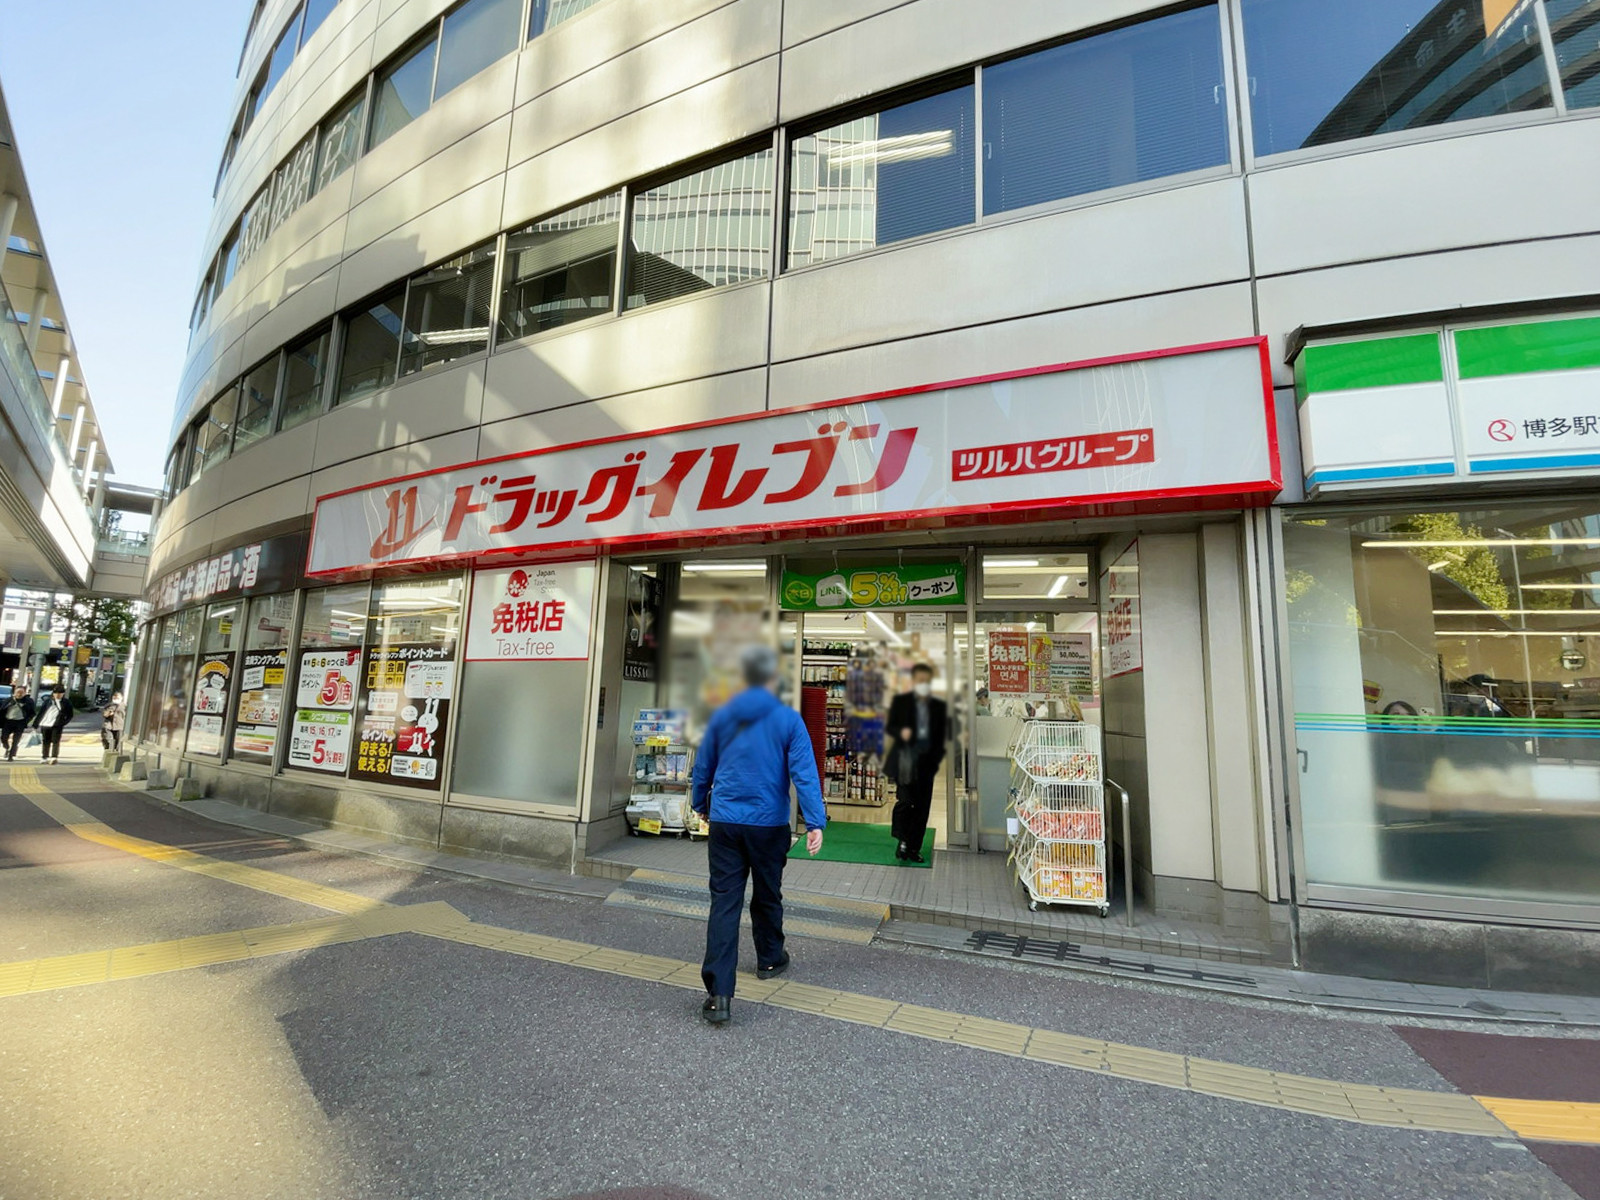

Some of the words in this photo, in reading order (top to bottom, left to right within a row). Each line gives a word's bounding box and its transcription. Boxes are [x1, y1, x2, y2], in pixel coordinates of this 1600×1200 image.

[1523, 415, 1600, 439] 博多駅
[959, 433, 1149, 477] ツルハグループ
[441, 421, 919, 542] ドラッグイレブン
[536, 569, 556, 577] Japan
[820, 586, 842, 597] LINE
[911, 581, 955, 597] クーポン
[491, 600, 566, 635] 免税店
[496, 637, 555, 656] Tax-free
[990, 645, 1027, 662] 免税
